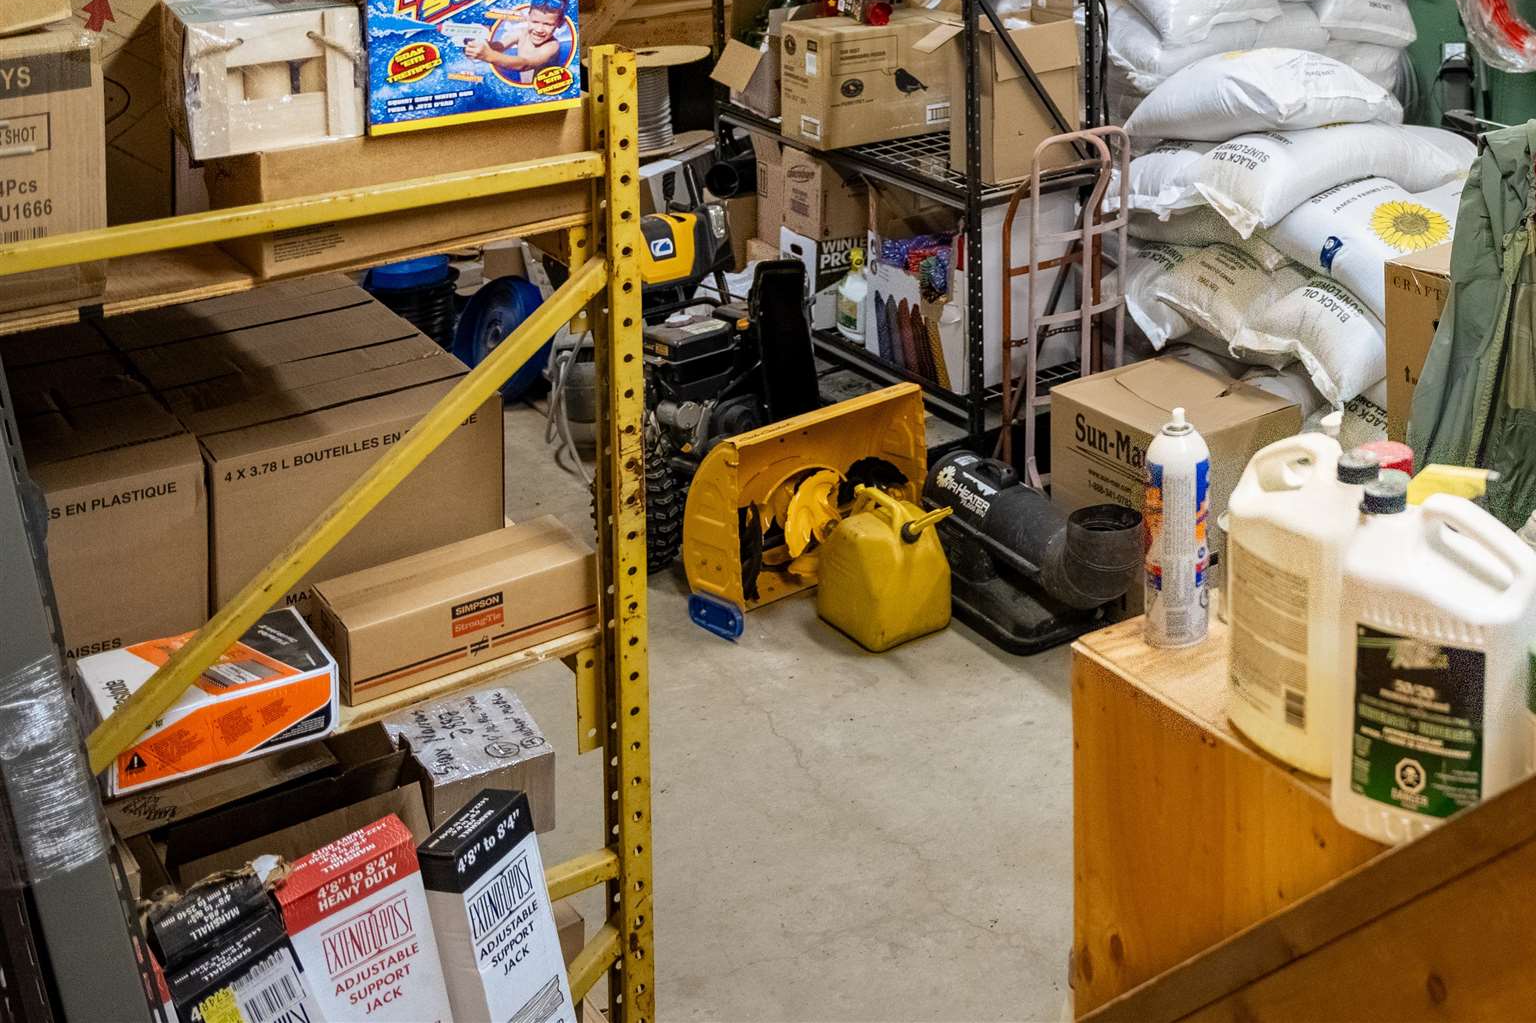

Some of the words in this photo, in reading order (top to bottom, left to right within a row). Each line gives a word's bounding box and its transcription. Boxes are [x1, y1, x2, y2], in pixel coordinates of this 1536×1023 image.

[1302, 287, 1318, 300] OIL
[1323, 298, 1350, 324] BLACK
[224, 471, 233, 484] 4
[236, 468, 246, 481] X
[249, 461, 278, 478] 3.78
[281, 459, 291, 470] L
[293, 435, 380, 467] BOUTEILLES
[382, 432, 401, 446] EN
[66, 502, 87, 519] EN
[91, 481, 177, 512] PLASTIQUE
[957, 481, 991, 511] HEATER
[455, 595, 500, 616] SIMPSON
[483, 834, 496, 852] to
[318, 884, 361, 913] HEAVY
[364, 863, 398, 892] DUTY
[349, 871, 364, 882] to
[189, 906, 240, 941] MARSHALL
[479, 899, 539, 961] ADJUSTABLE
[490, 922, 535, 968] SUPPORT
[503, 943, 531, 976] JACK
[335, 942, 421, 997] ADJUSTABLE
[348, 963, 412, 1005] SUPPORT
[365, 986, 403, 1015] JACK
